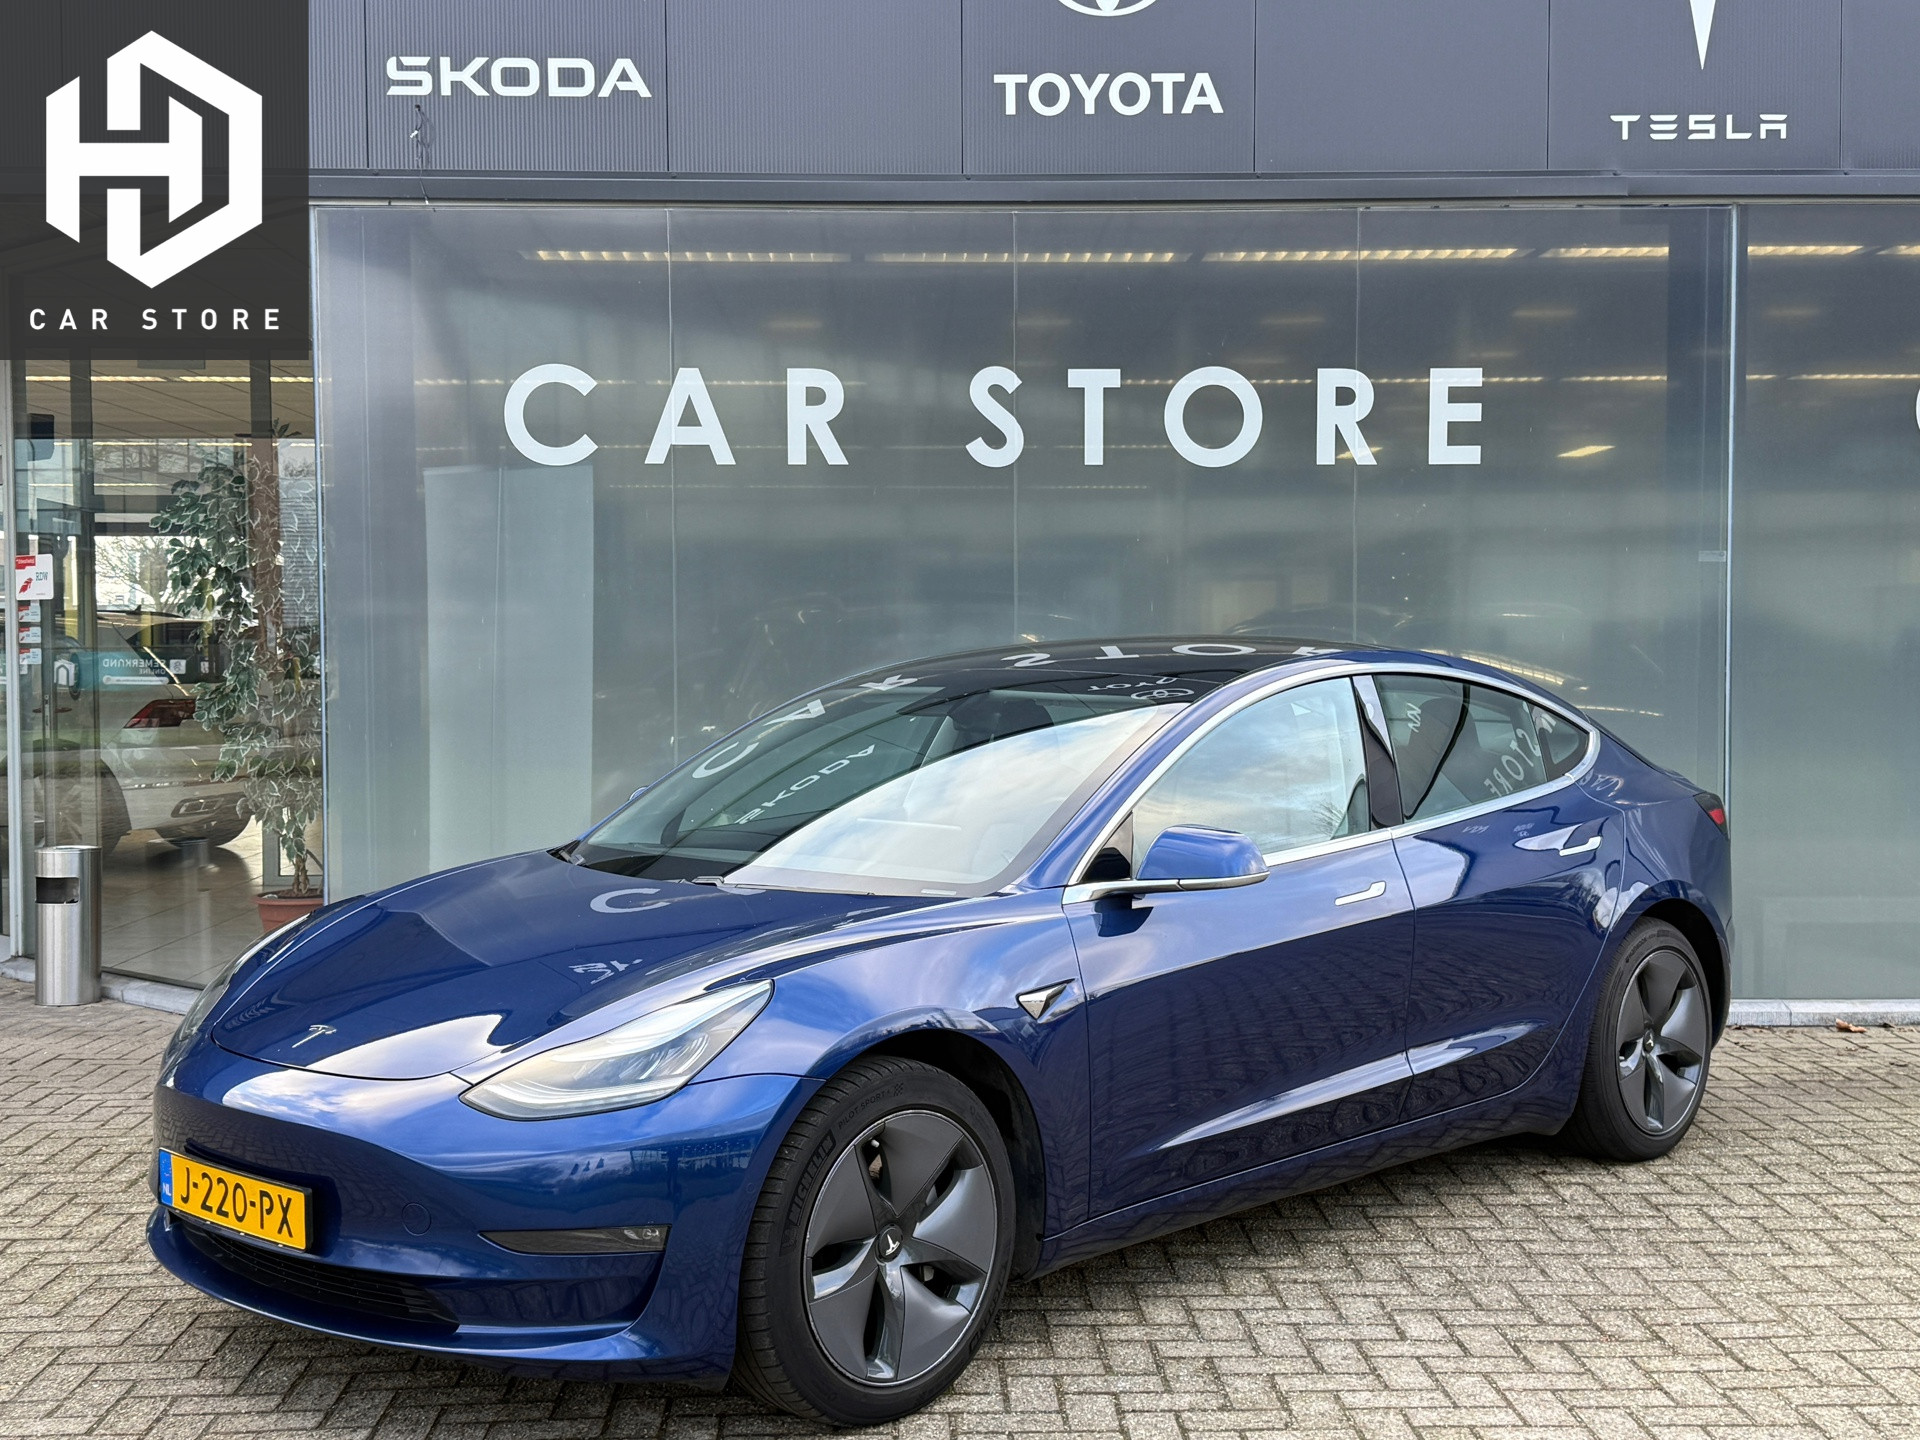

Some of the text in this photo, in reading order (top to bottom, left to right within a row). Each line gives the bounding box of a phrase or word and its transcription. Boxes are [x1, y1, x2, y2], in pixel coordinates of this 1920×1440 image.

[386, 55, 653, 98] SKODA
[993, 72, 1225, 117] TOYOTA
[1609, 113, 1789, 141] TESLA
[503, 363, 1483, 468] CAR STORE
[162, 1166, 294, 1239] NL J-220-PX
[788, 1134, 837, 1226] MICHELIN
